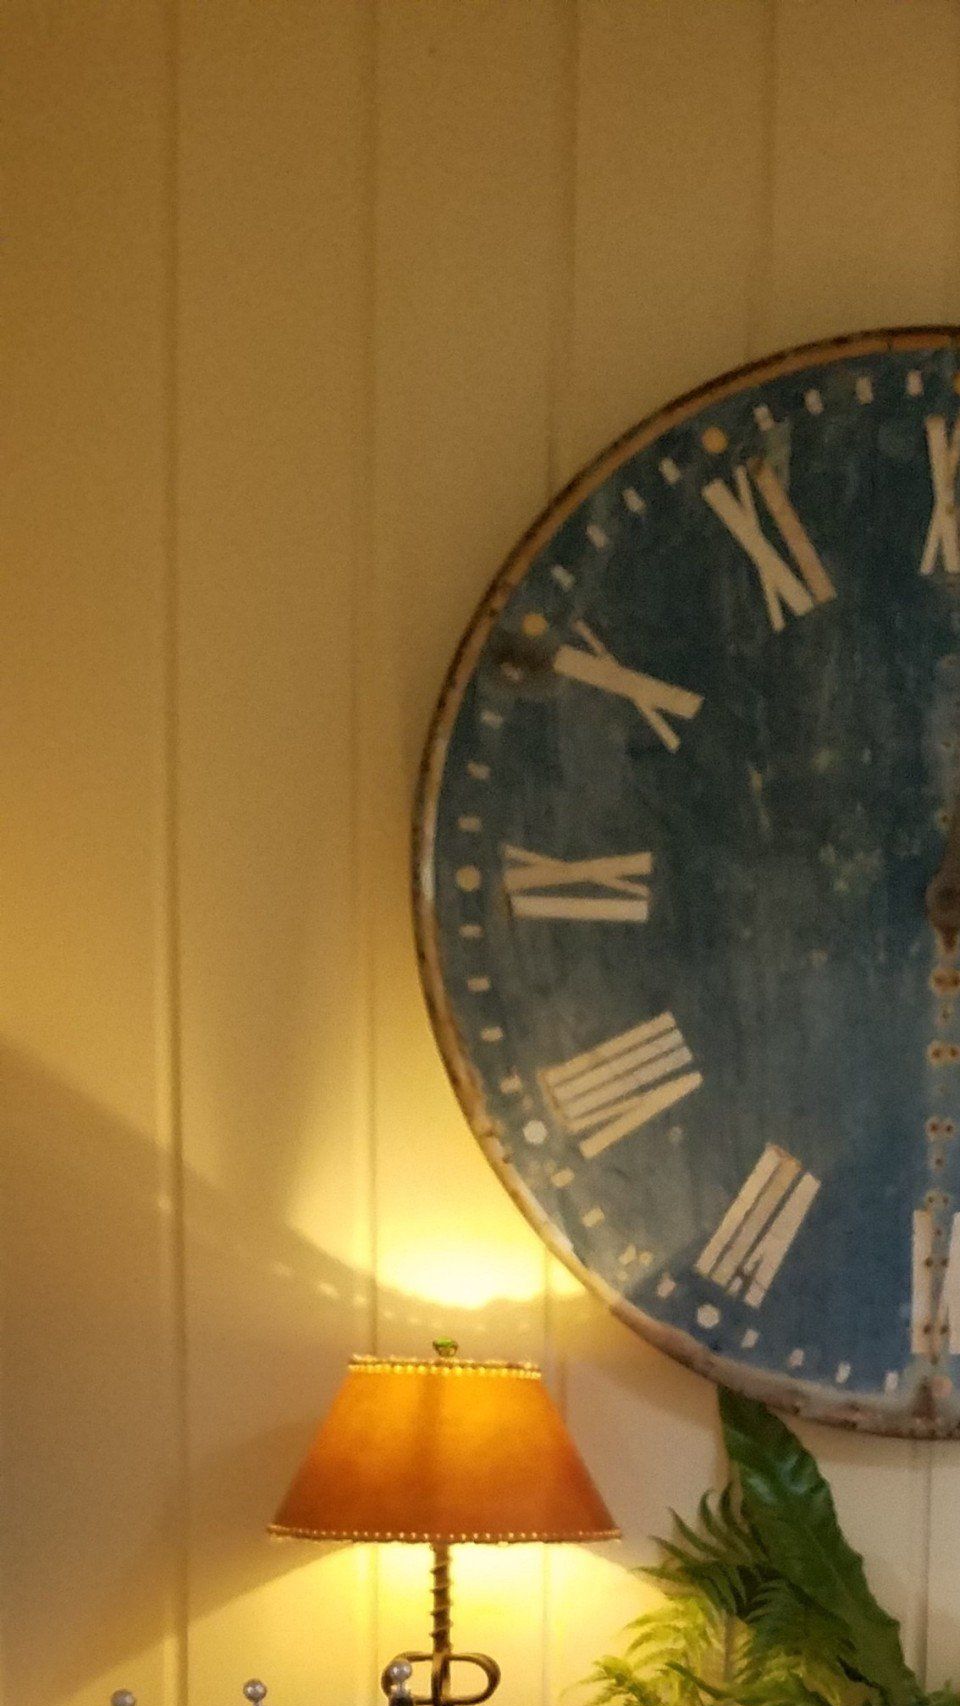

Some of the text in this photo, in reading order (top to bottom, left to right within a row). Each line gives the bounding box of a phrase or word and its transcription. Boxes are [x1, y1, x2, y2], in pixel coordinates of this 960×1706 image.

[702, 460, 837, 633] XI
[552, 616, 705, 753] X
[503, 844, 654, 923] IX
[537, 1010, 704, 1160] VIII
[694, 1143, 822, 1309] VII
